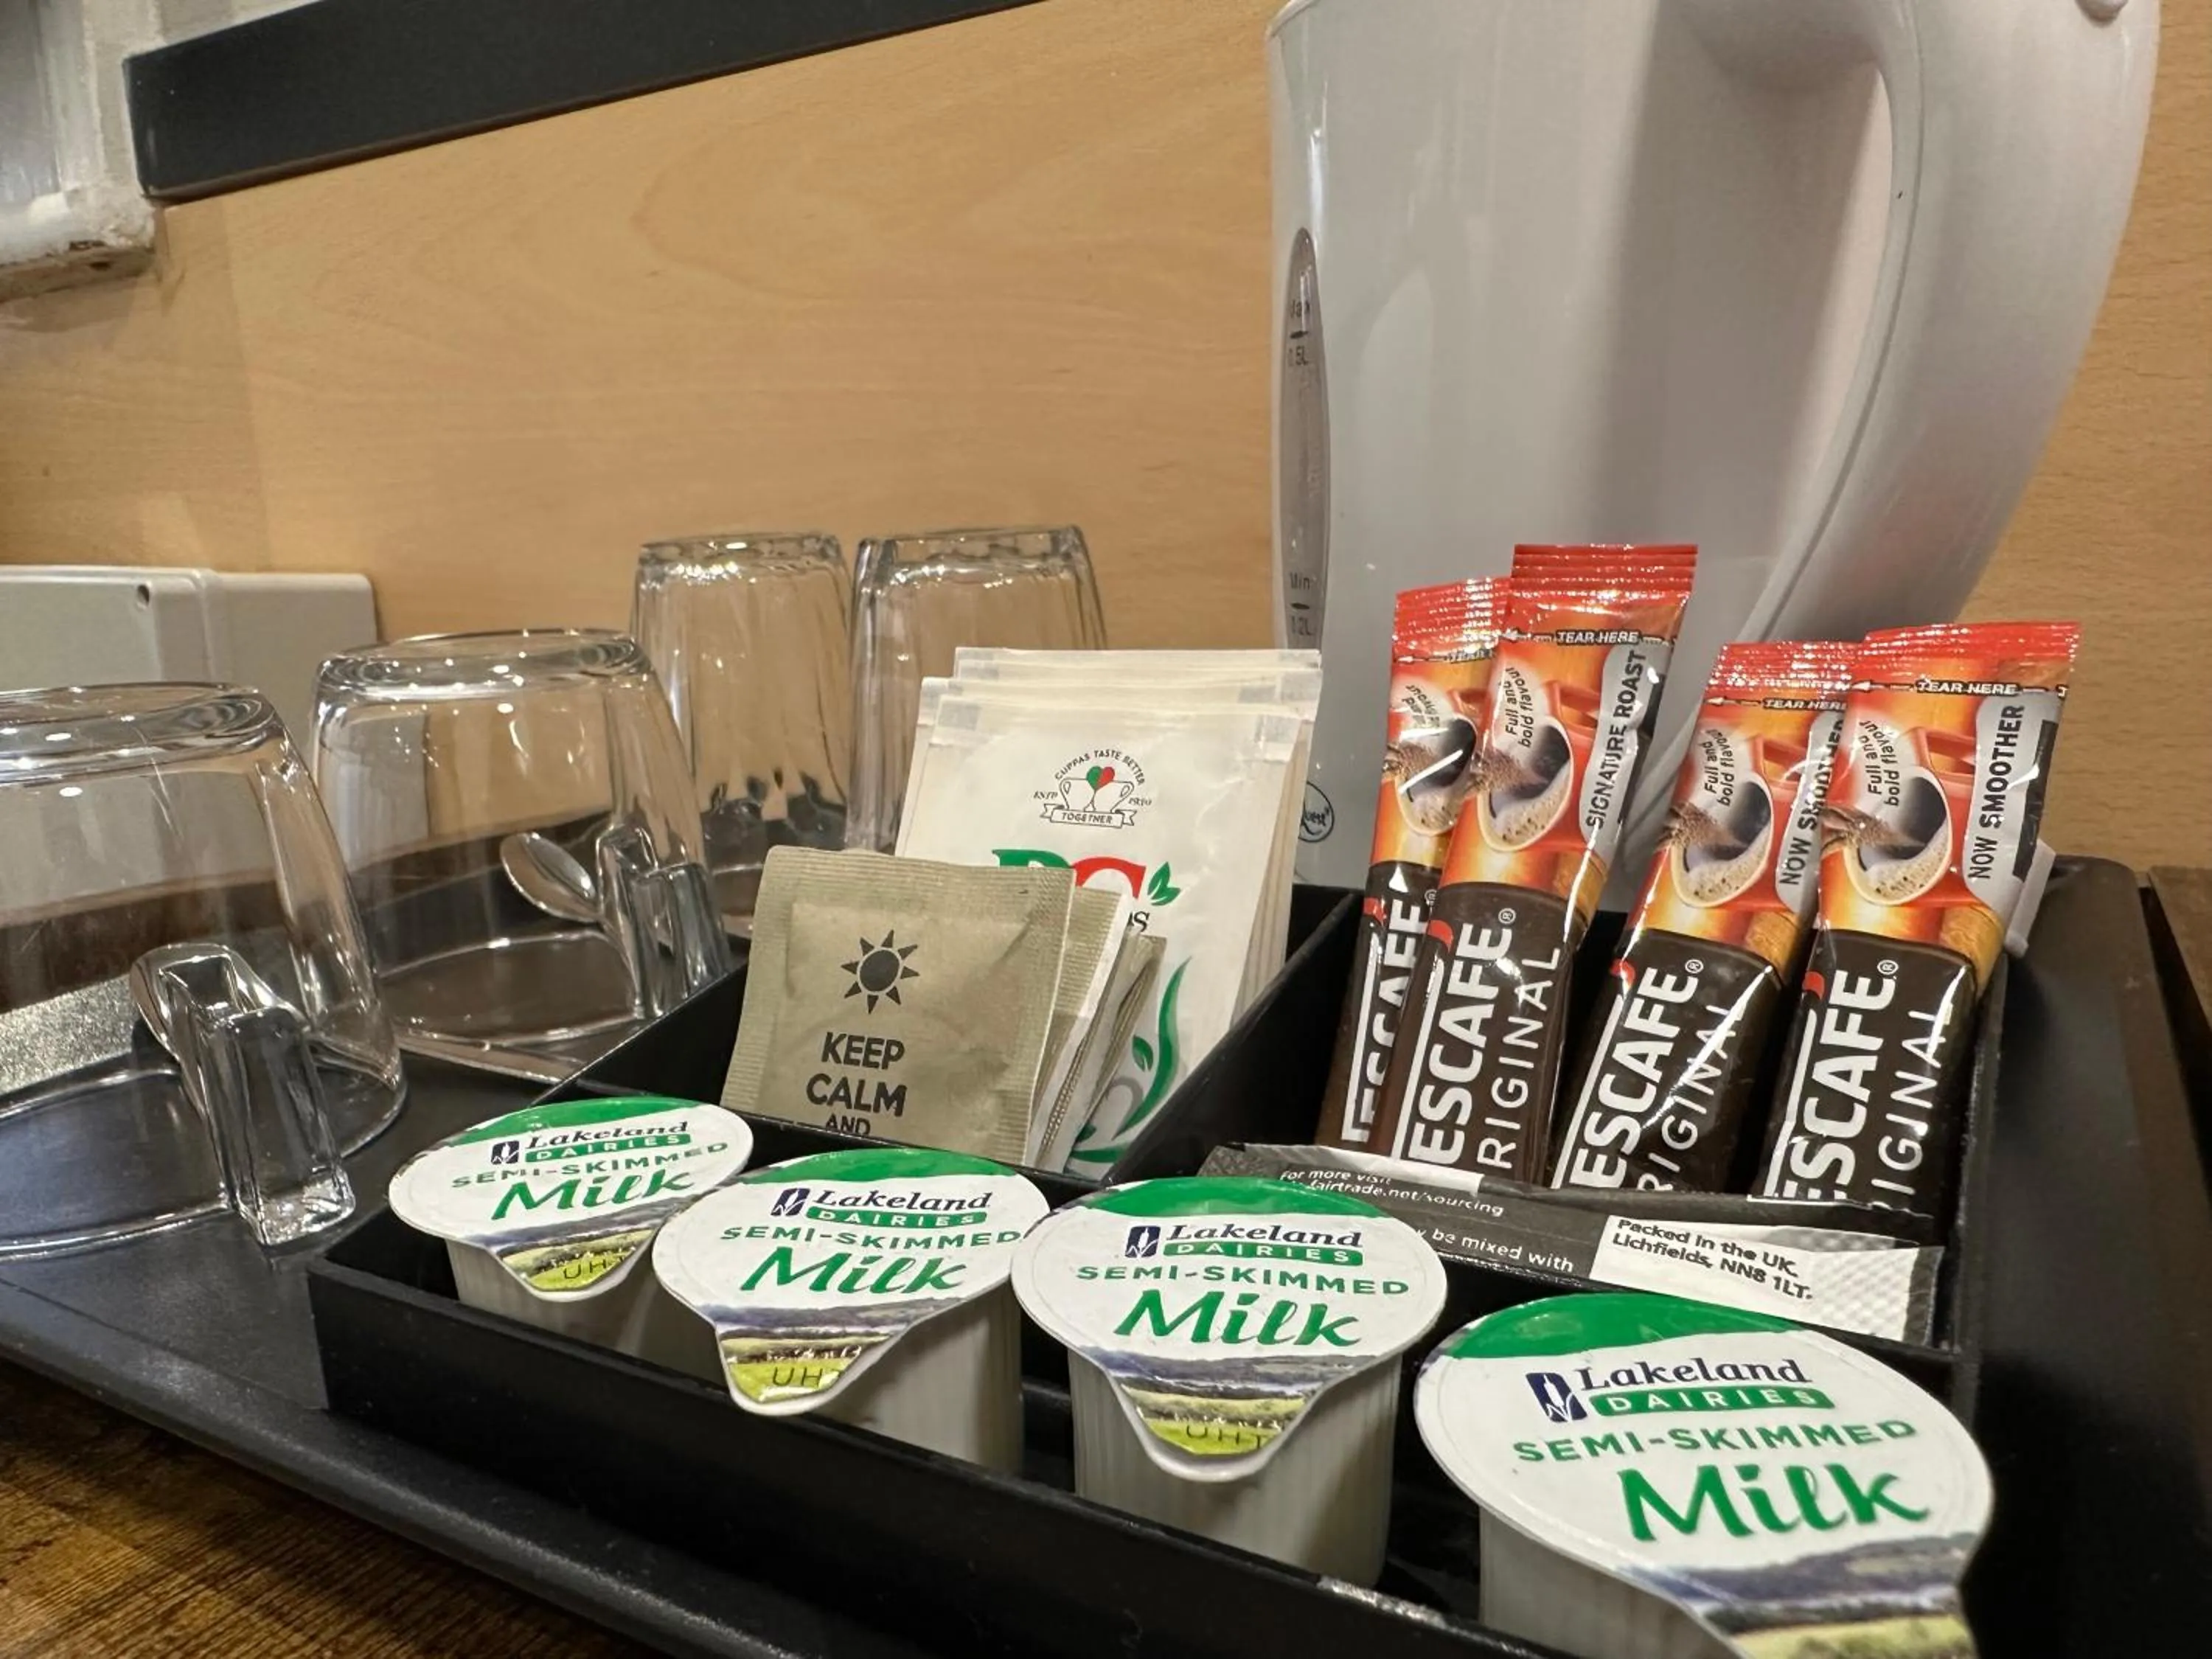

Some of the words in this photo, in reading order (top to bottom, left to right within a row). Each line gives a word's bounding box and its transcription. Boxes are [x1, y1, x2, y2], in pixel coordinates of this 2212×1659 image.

[1558, 632, 1595, 643] TEAR
[1599, 632, 1638, 643] HERE
[1506, 667, 1533, 712] flavour
[1765, 700, 1805, 709] TEAR
[1919, 681, 1961, 693] TEAR
[1968, 683, 2018, 695] HERE
[1505, 709, 1517, 735] Full
[1518, 715, 1534, 748] bold
[1586, 726, 1627, 830] SIGNATURE
[1613, 650, 1646, 718] ROAST
[1698, 742, 1717, 762] and
[1860, 720, 1899, 764] flavour
[1055, 753, 1090, 780] CUPPAS
[1093, 749, 1122, 760] TASTE
[1122, 755, 1146, 785] BETTER
[1705, 767, 1719, 793] Full
[1865, 764, 1882, 794] Full
[1979, 705, 2025, 828] SMOOTHER
[1717, 771, 1734, 806] bold
[1884, 770, 1899, 806] bold
[1062, 812, 1113, 824] TOGETHER
[1779, 838, 1811, 885] NOW
[1968, 836, 1997, 879] NOW
[821, 1032, 905, 1070] KEEP
[1477, 947, 1561, 1170] RIGINAL
[806, 1073, 908, 1117] CALM
[1638, 1004, 1747, 1191] RIGINAL
[529, 1121, 688, 1149] Lakeland
[825, 1113, 871, 1135] AND
[536, 1135, 681, 1161] DAIRIES
[453, 1143, 728, 1188] SEMI-SKIMMED
[1309, 1169, 1352, 1180] more
[491, 1169, 695, 1220] Milk
[813, 1189, 993, 1211] Lakeland
[817, 1210, 975, 1227] DAIRIES
[1166, 1223, 1363, 1248] Lakeland
[720, 1226, 1022, 1250] SEMI-SKIMMED
[1178, 1243, 1351, 1263] DAIRIES
[1433, 1228, 1455, 1244] be
[1461, 1237, 1523, 1259] mixed
[1528, 1251, 1573, 1273] with
[1617, 1219, 1690, 1244] Packed
[1721, 1242, 1757, 1262] the
[563, 1256, 622, 1279] UH
[740, 1246, 967, 1294] Milk
[1076, 1265, 1409, 1295] SEMI-SKIMMED
[1113, 1290, 1362, 1346] Milk
[1575, 1357, 1812, 1391] Lakeland
[1607, 1389, 1819, 1413] DAIRIES
[1513, 1419, 1917, 1462] SEMI-SKIMMED
[1617, 1464, 1930, 1542] Milk
